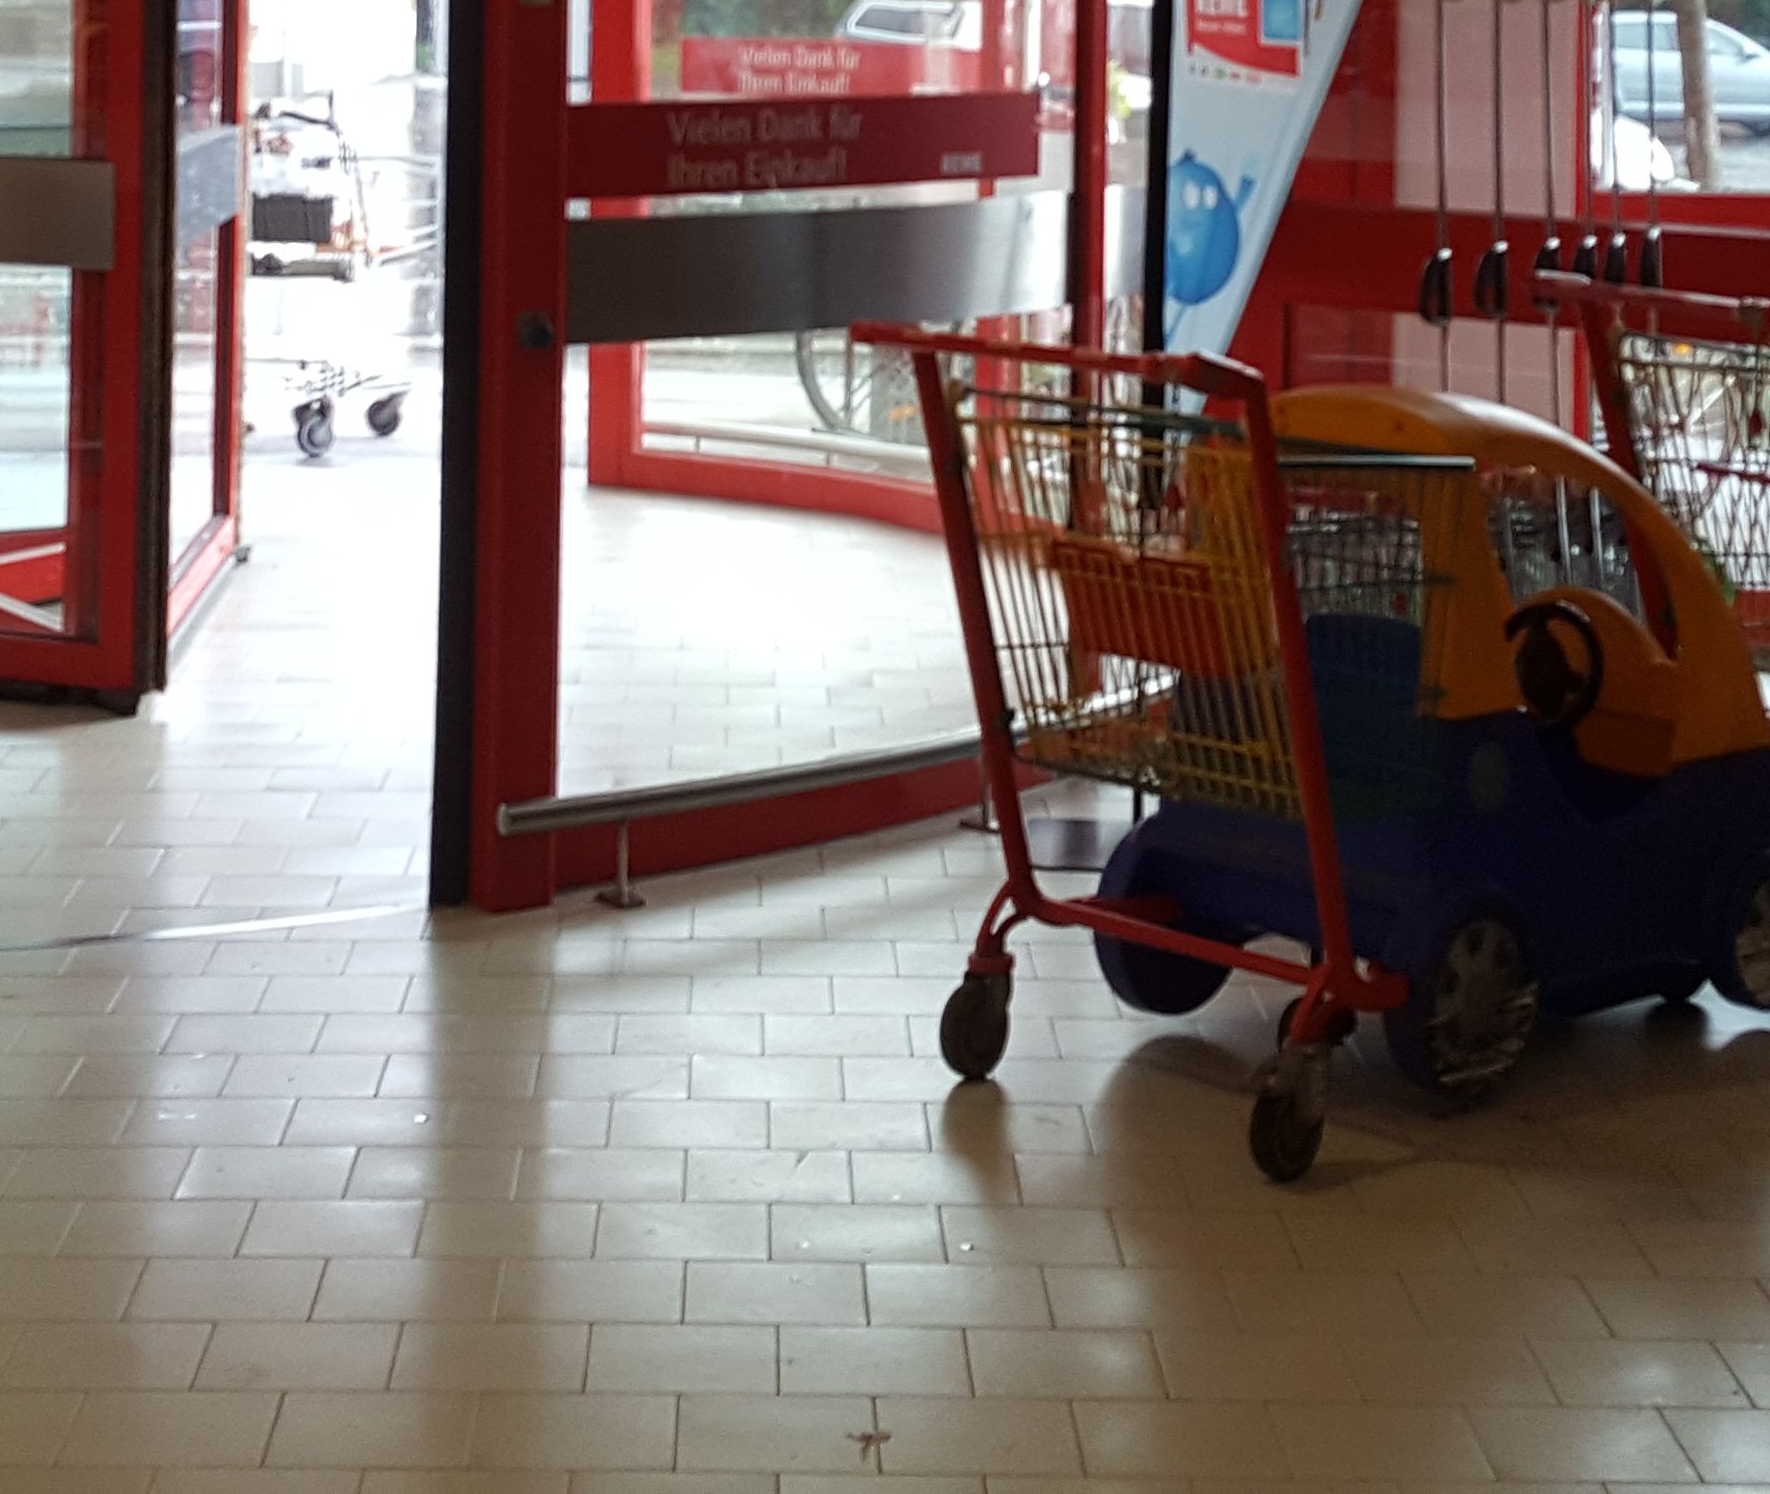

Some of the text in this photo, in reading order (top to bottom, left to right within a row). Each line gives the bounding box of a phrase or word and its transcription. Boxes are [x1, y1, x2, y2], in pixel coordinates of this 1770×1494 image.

[738, 47, 791, 68] Vielen
[793, 46, 836, 68] Dank
[737, 71, 783, 92] Ihren
[668, 104, 863, 145] Vielen Dank für
[667, 151, 739, 189] Ihren
